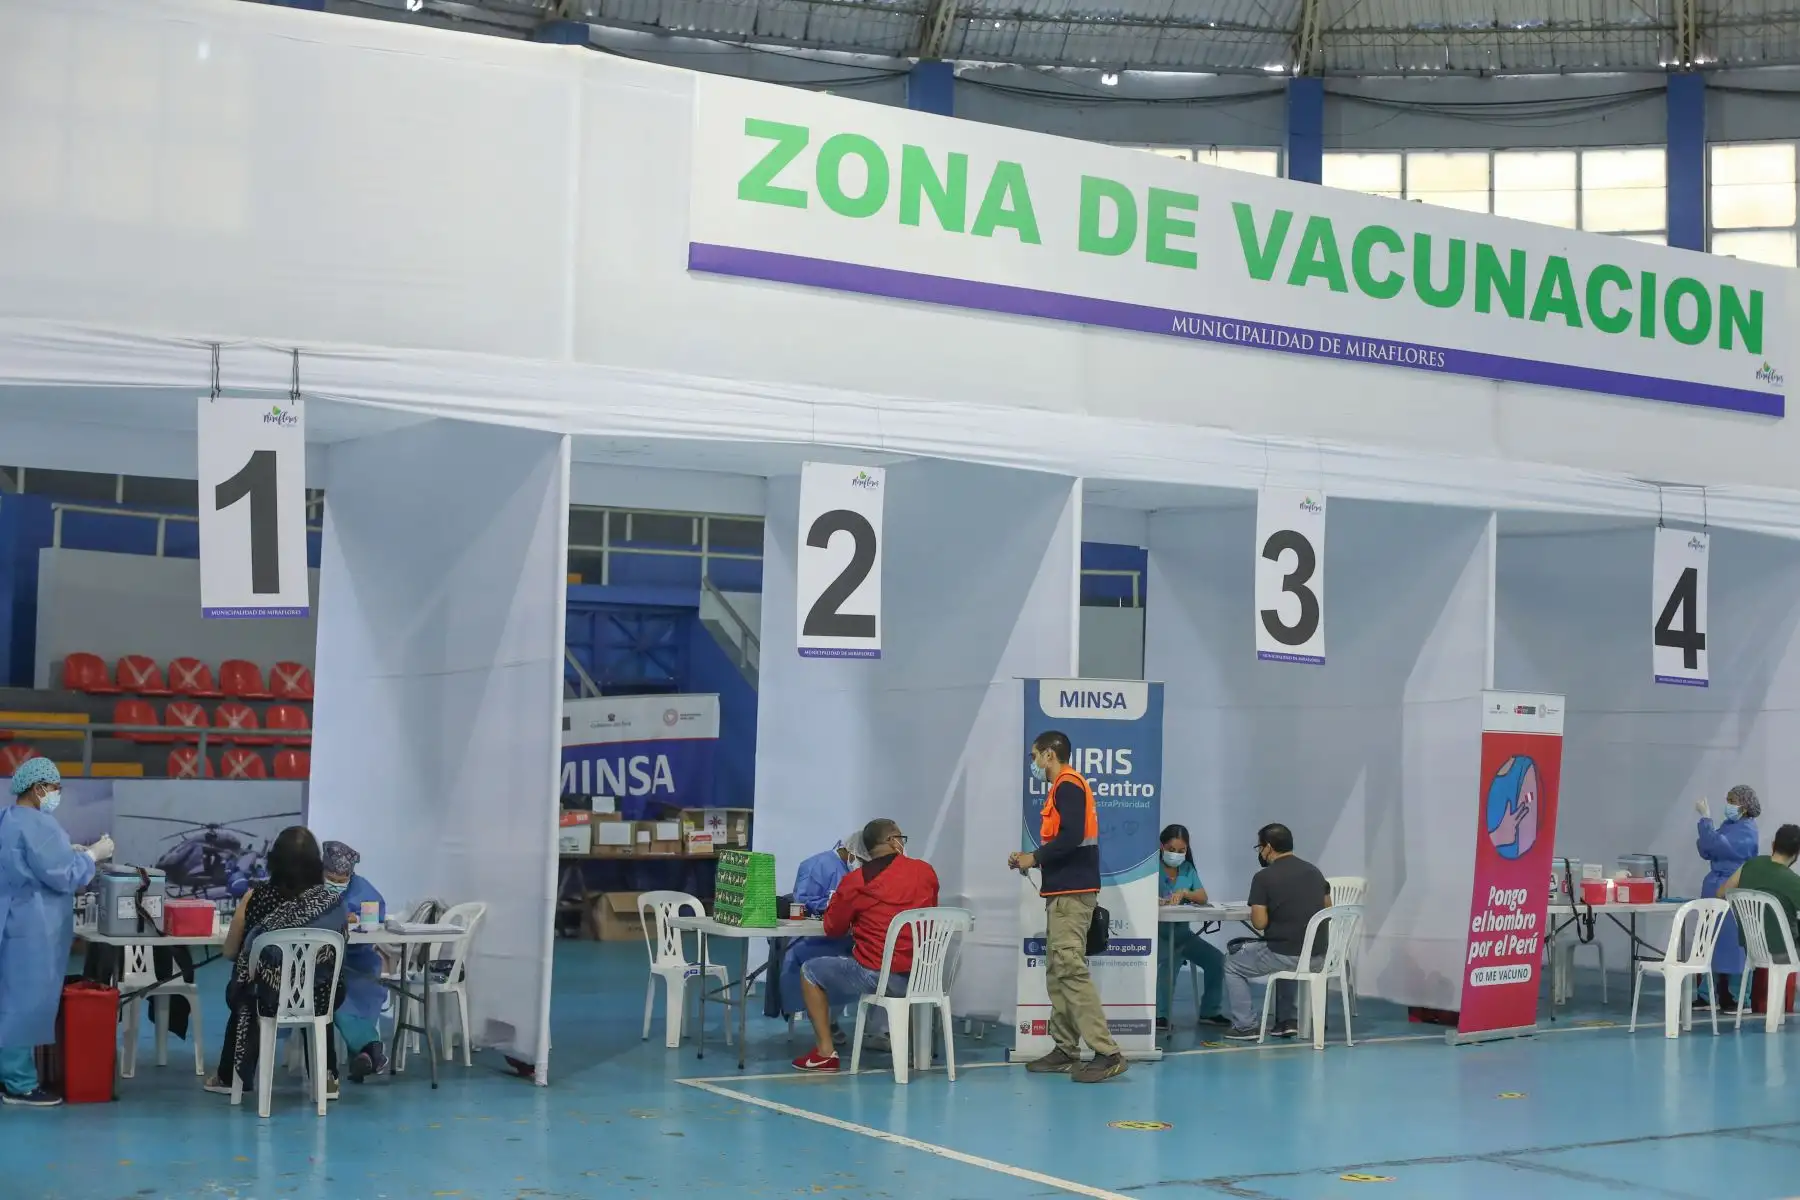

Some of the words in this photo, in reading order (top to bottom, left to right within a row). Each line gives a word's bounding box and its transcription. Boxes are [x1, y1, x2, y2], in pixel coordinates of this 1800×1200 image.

[738, 117, 1042, 245] ZONA
[1078, 175, 1199, 270] DE
[1231, 202, 1764, 355] VACUNACION
[1172, 315, 1314, 350] MUNICIPALIDAD
[1320, 336, 1341, 354] DE
[1346, 342, 1445, 367] MIRAFLORES
[215, 450, 280, 594] 1
[803, 509, 877, 638] 2
[1260, 529, 1320, 646] 3
[1655, 567, 1706, 670] 4
[1060, 690, 1127, 709] MINSA
[1069, 748, 1132, 775] IRIS
[1488, 886, 1527, 911] Pongo
[1472, 911, 1488, 932] el
[1487, 909, 1536, 931] hombro
[1468, 940, 1493, 964] por
[1495, 934, 1508, 956] el
[1508, 932, 1539, 955] Perú
[1475, 973, 1483, 982] YO
[1486, 971, 1497, 981] ME
[1499, 968, 1528, 980] VACUNO
